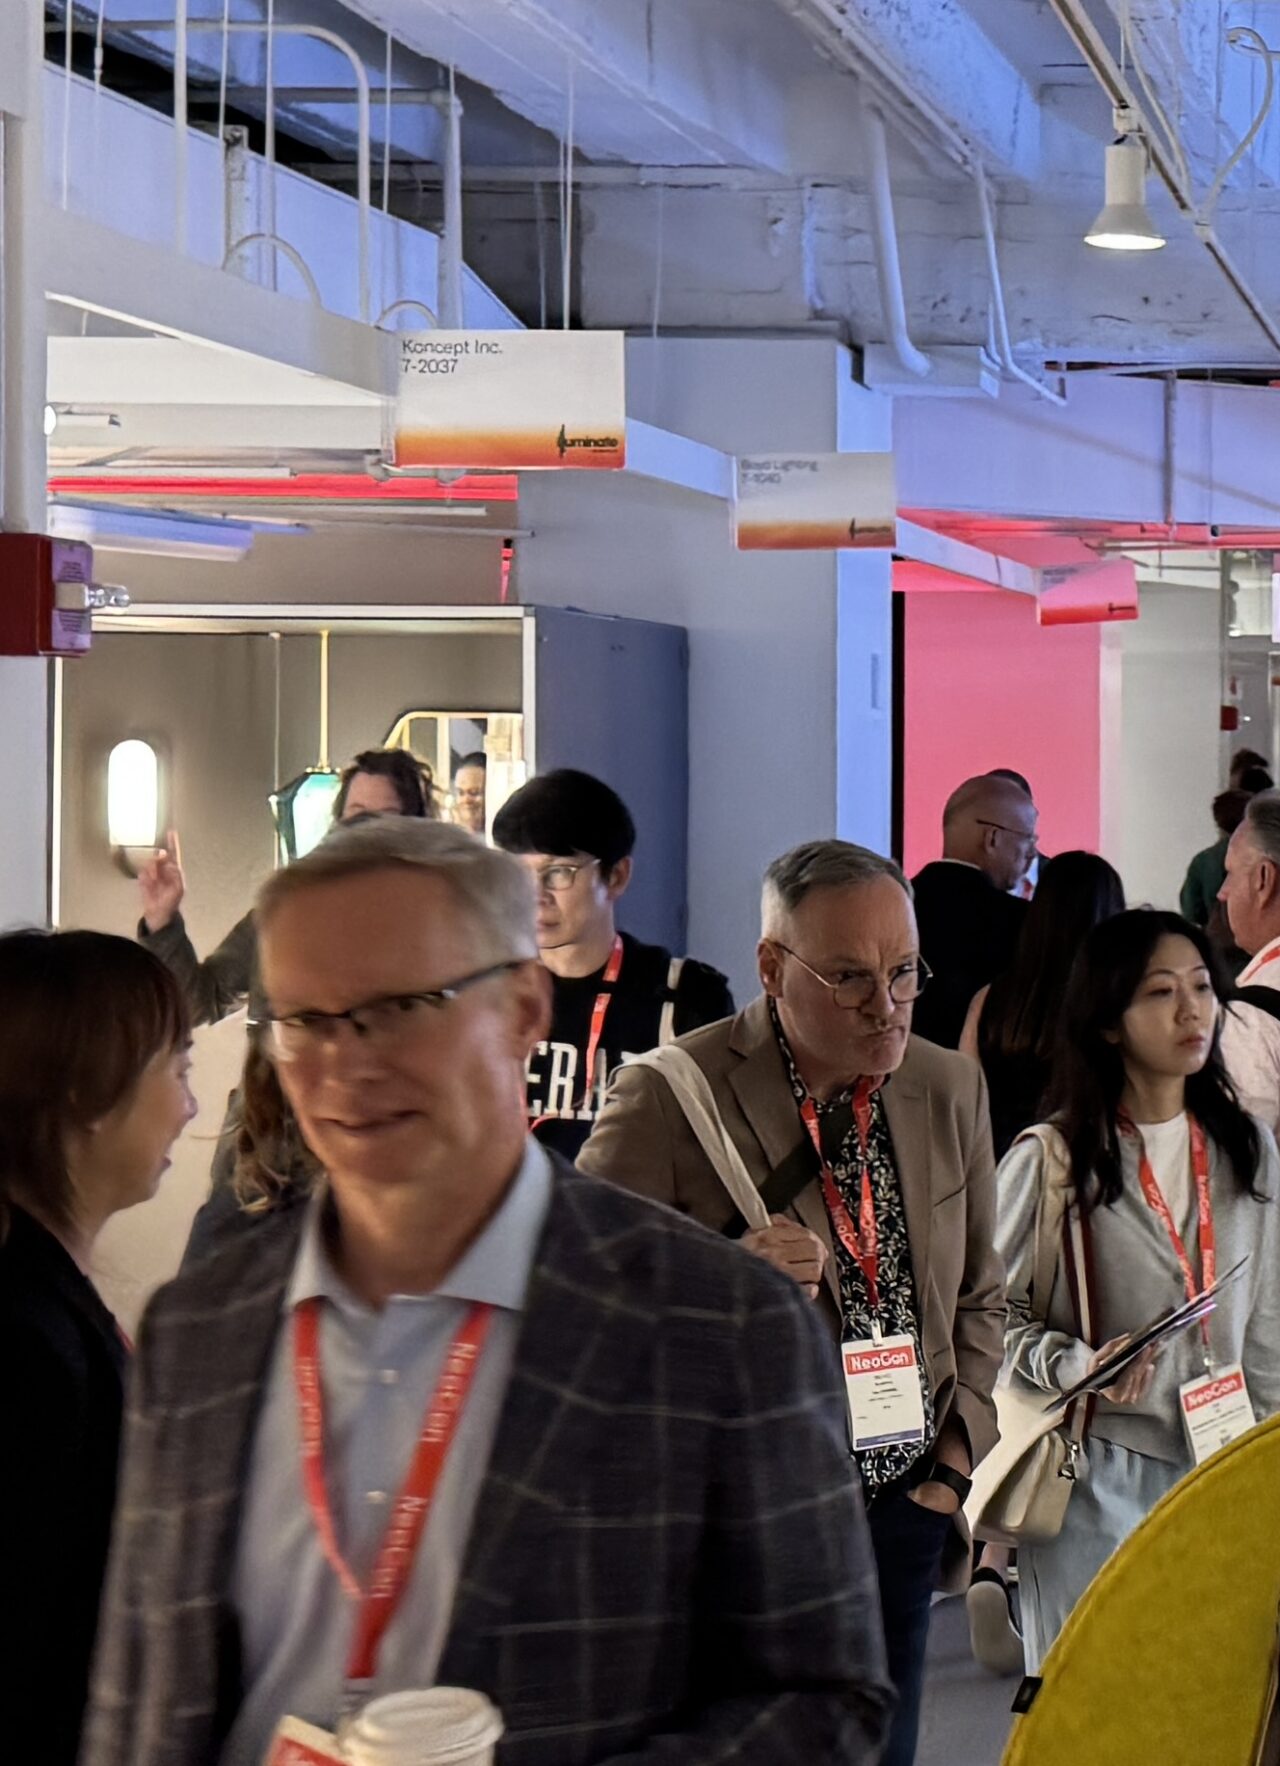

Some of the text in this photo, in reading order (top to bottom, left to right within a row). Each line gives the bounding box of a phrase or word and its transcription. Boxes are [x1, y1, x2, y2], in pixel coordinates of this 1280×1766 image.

[402, 338, 503, 357] Koncept Inc.
[402, 358, 458, 374] 7-2037
[850, 1351, 910, 1371] NeoCon
[1186, 1379, 1239, 1409] NeoCon
